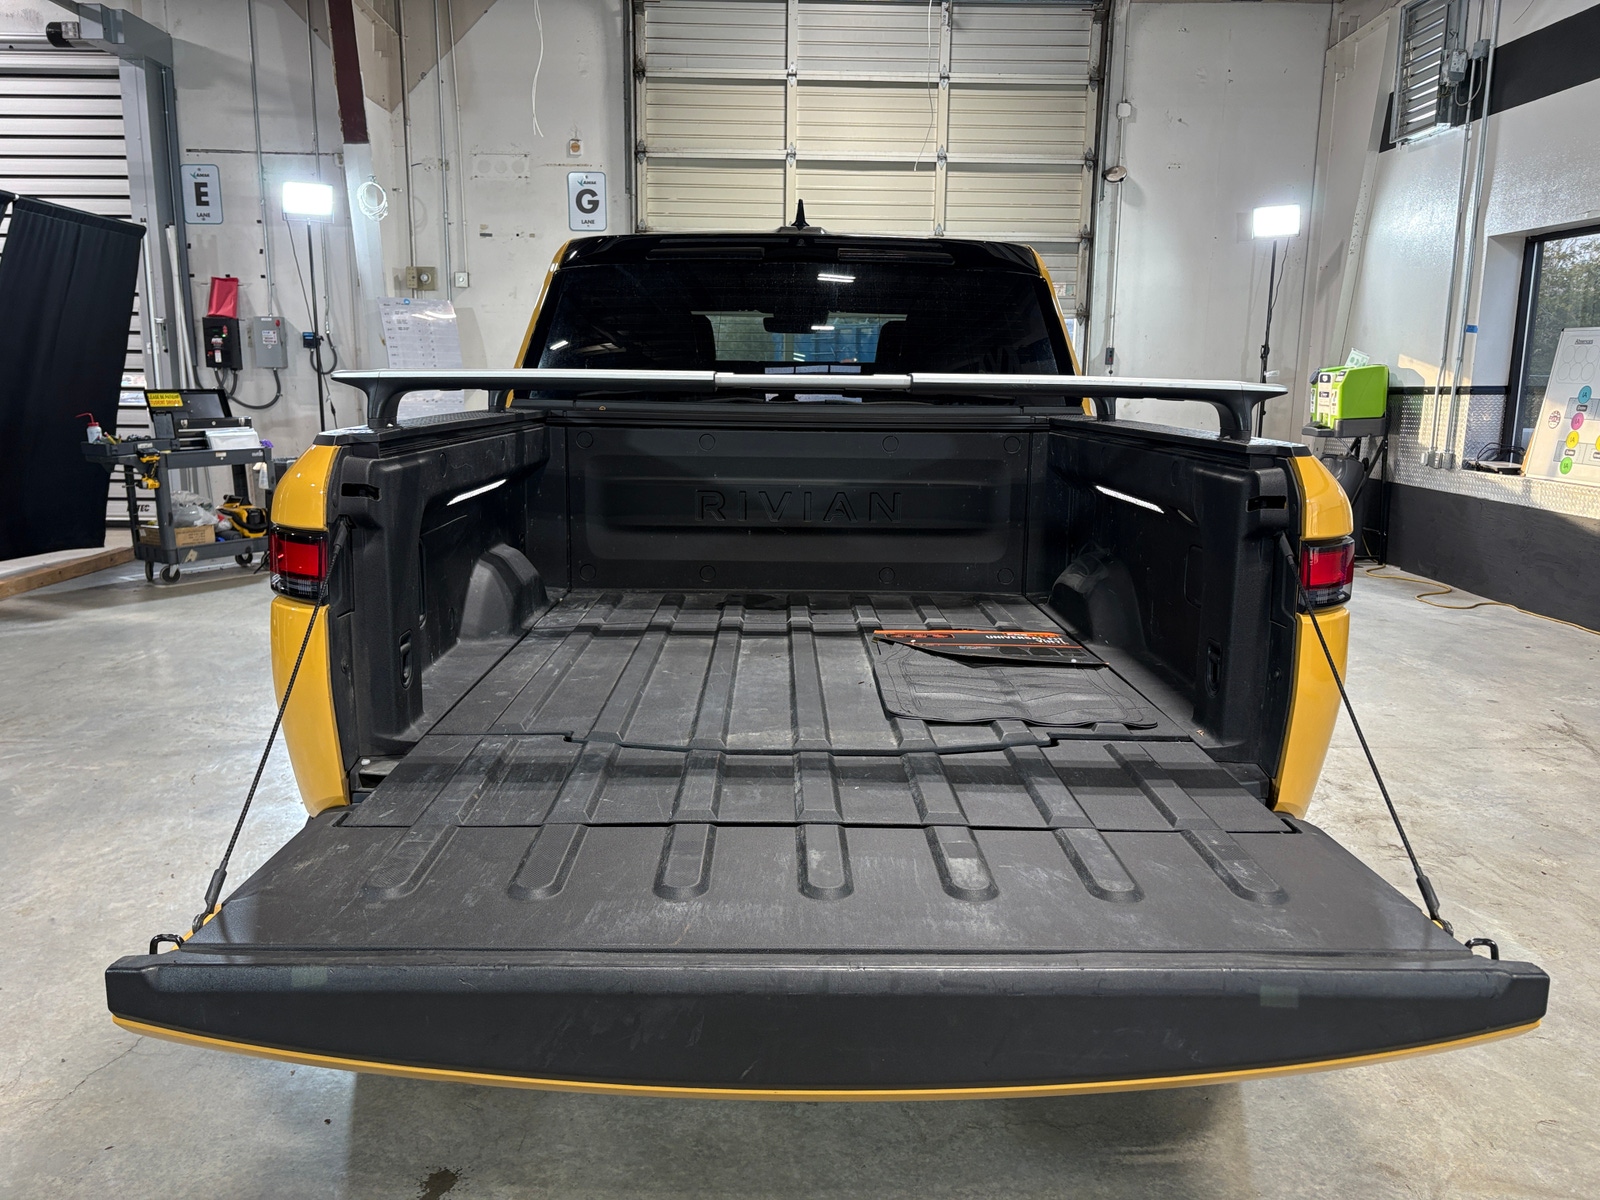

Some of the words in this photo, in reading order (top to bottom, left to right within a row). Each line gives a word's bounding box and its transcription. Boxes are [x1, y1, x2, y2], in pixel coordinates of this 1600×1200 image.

[194, 182, 210, 206] E
[575, 188, 600, 214] G
[695, 490, 901, 523] RIVIAN
